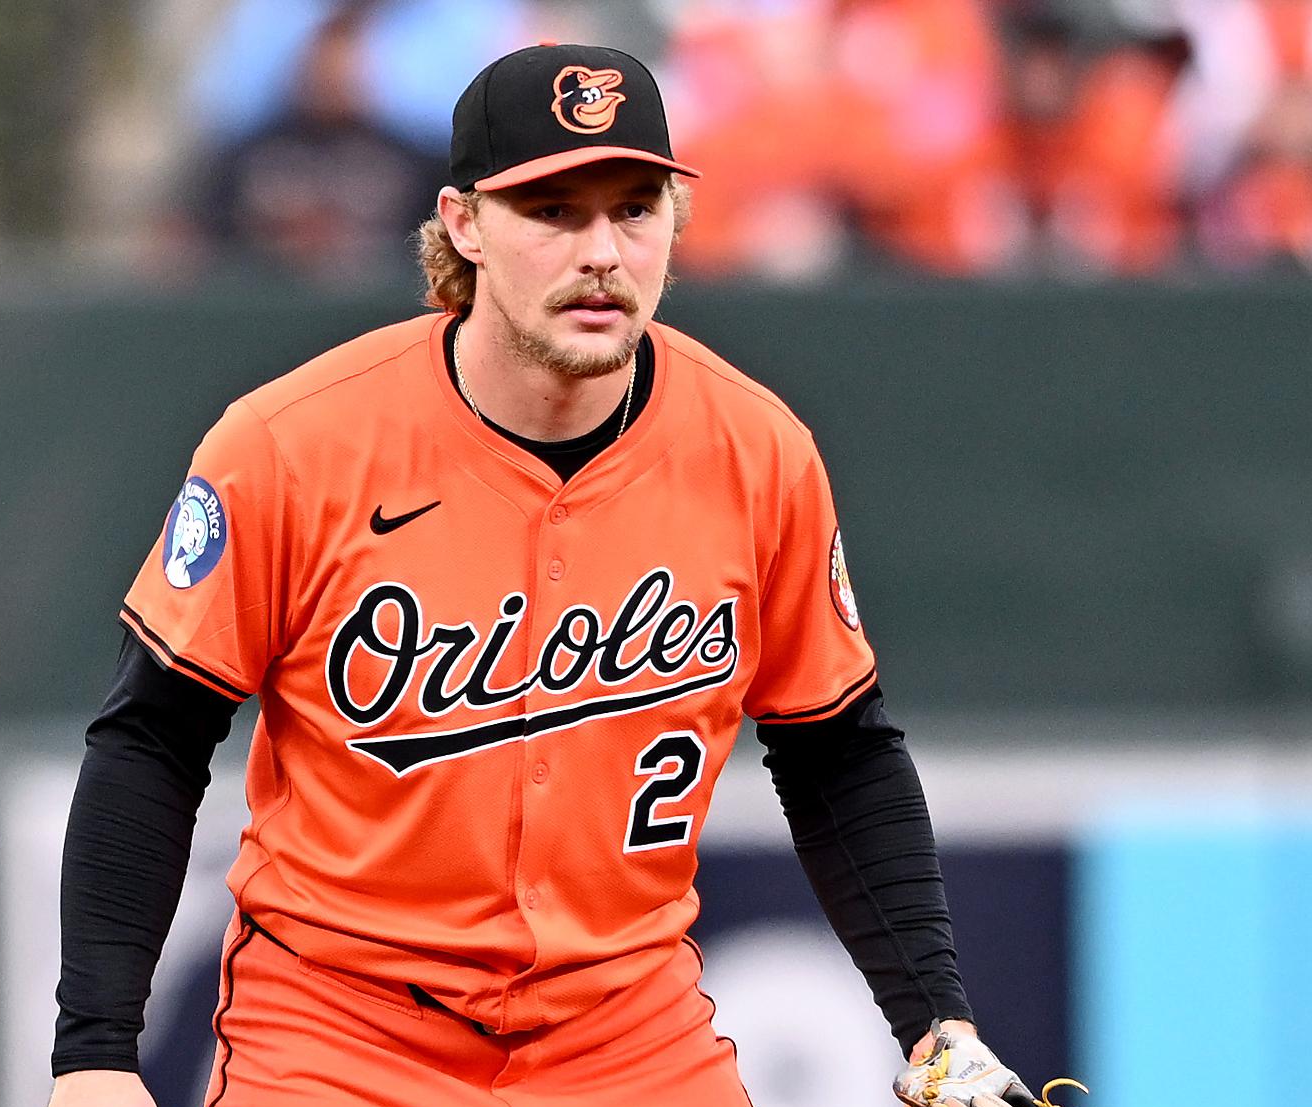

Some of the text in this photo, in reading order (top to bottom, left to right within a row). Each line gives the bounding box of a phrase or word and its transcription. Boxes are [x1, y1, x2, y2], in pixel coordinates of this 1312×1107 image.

[203, 493, 221, 540] Price
[325, 566, 741, 728] Orioles
[623, 730, 709, 856] 2
